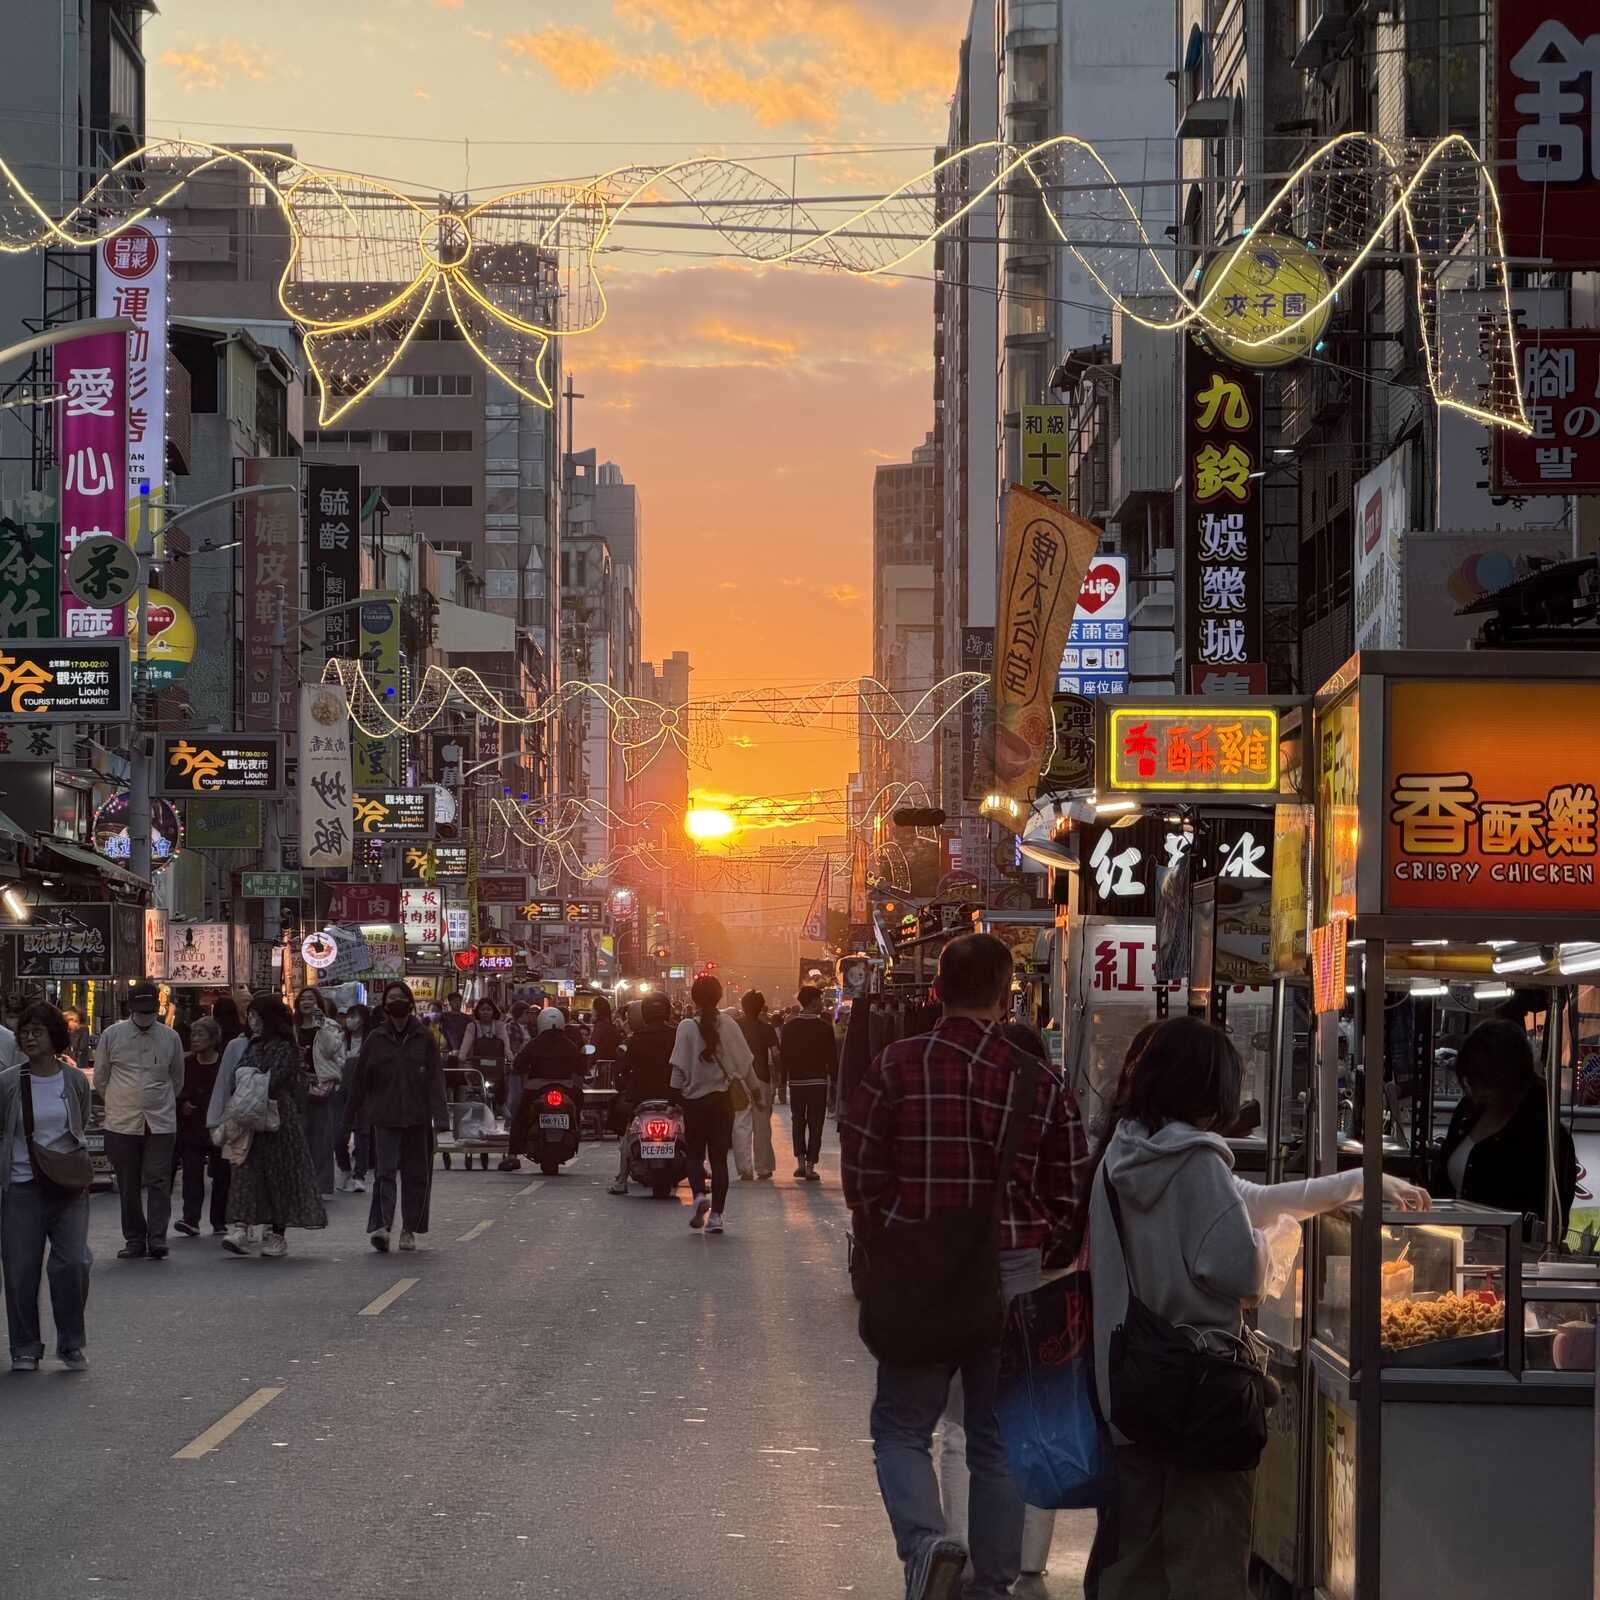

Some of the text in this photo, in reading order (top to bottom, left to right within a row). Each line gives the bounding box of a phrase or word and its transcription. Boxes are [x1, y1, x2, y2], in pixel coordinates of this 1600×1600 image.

[115, 238, 149, 252] 台灣
[114, 253, 149, 269] 運彩
[1224, 293, 1307, 318] 夾子園
[1523, 347, 1600, 399] 腳
[1025, 416, 1064, 434] 和級
[1535, 446, 1578, 479] 발
[65, 368, 114, 637] 愛心摩
[320, 488, 350, 550] 毓齡
[75, 544, 130, 600] 茶
[56, 671, 109, 686] 觀光夜市
[79, 687, 110, 696] Liouhe
[1083, 681, 1123, 694] 座位區
[251, 691, 270, 704] RED
[1124, 721, 1269, 778] 香酥雞
[227, 759, 269, 770] 觀光夜市
[244, 771, 269, 779] Liouhe
[385, 794, 424, 805] 觀光夜市
[1391, 771, 1598, 858] 香酥雞
[1394, 861, 1595, 884] CRISPY CHICKEN
[479, 956, 513, 968] 木瓜牛奶
